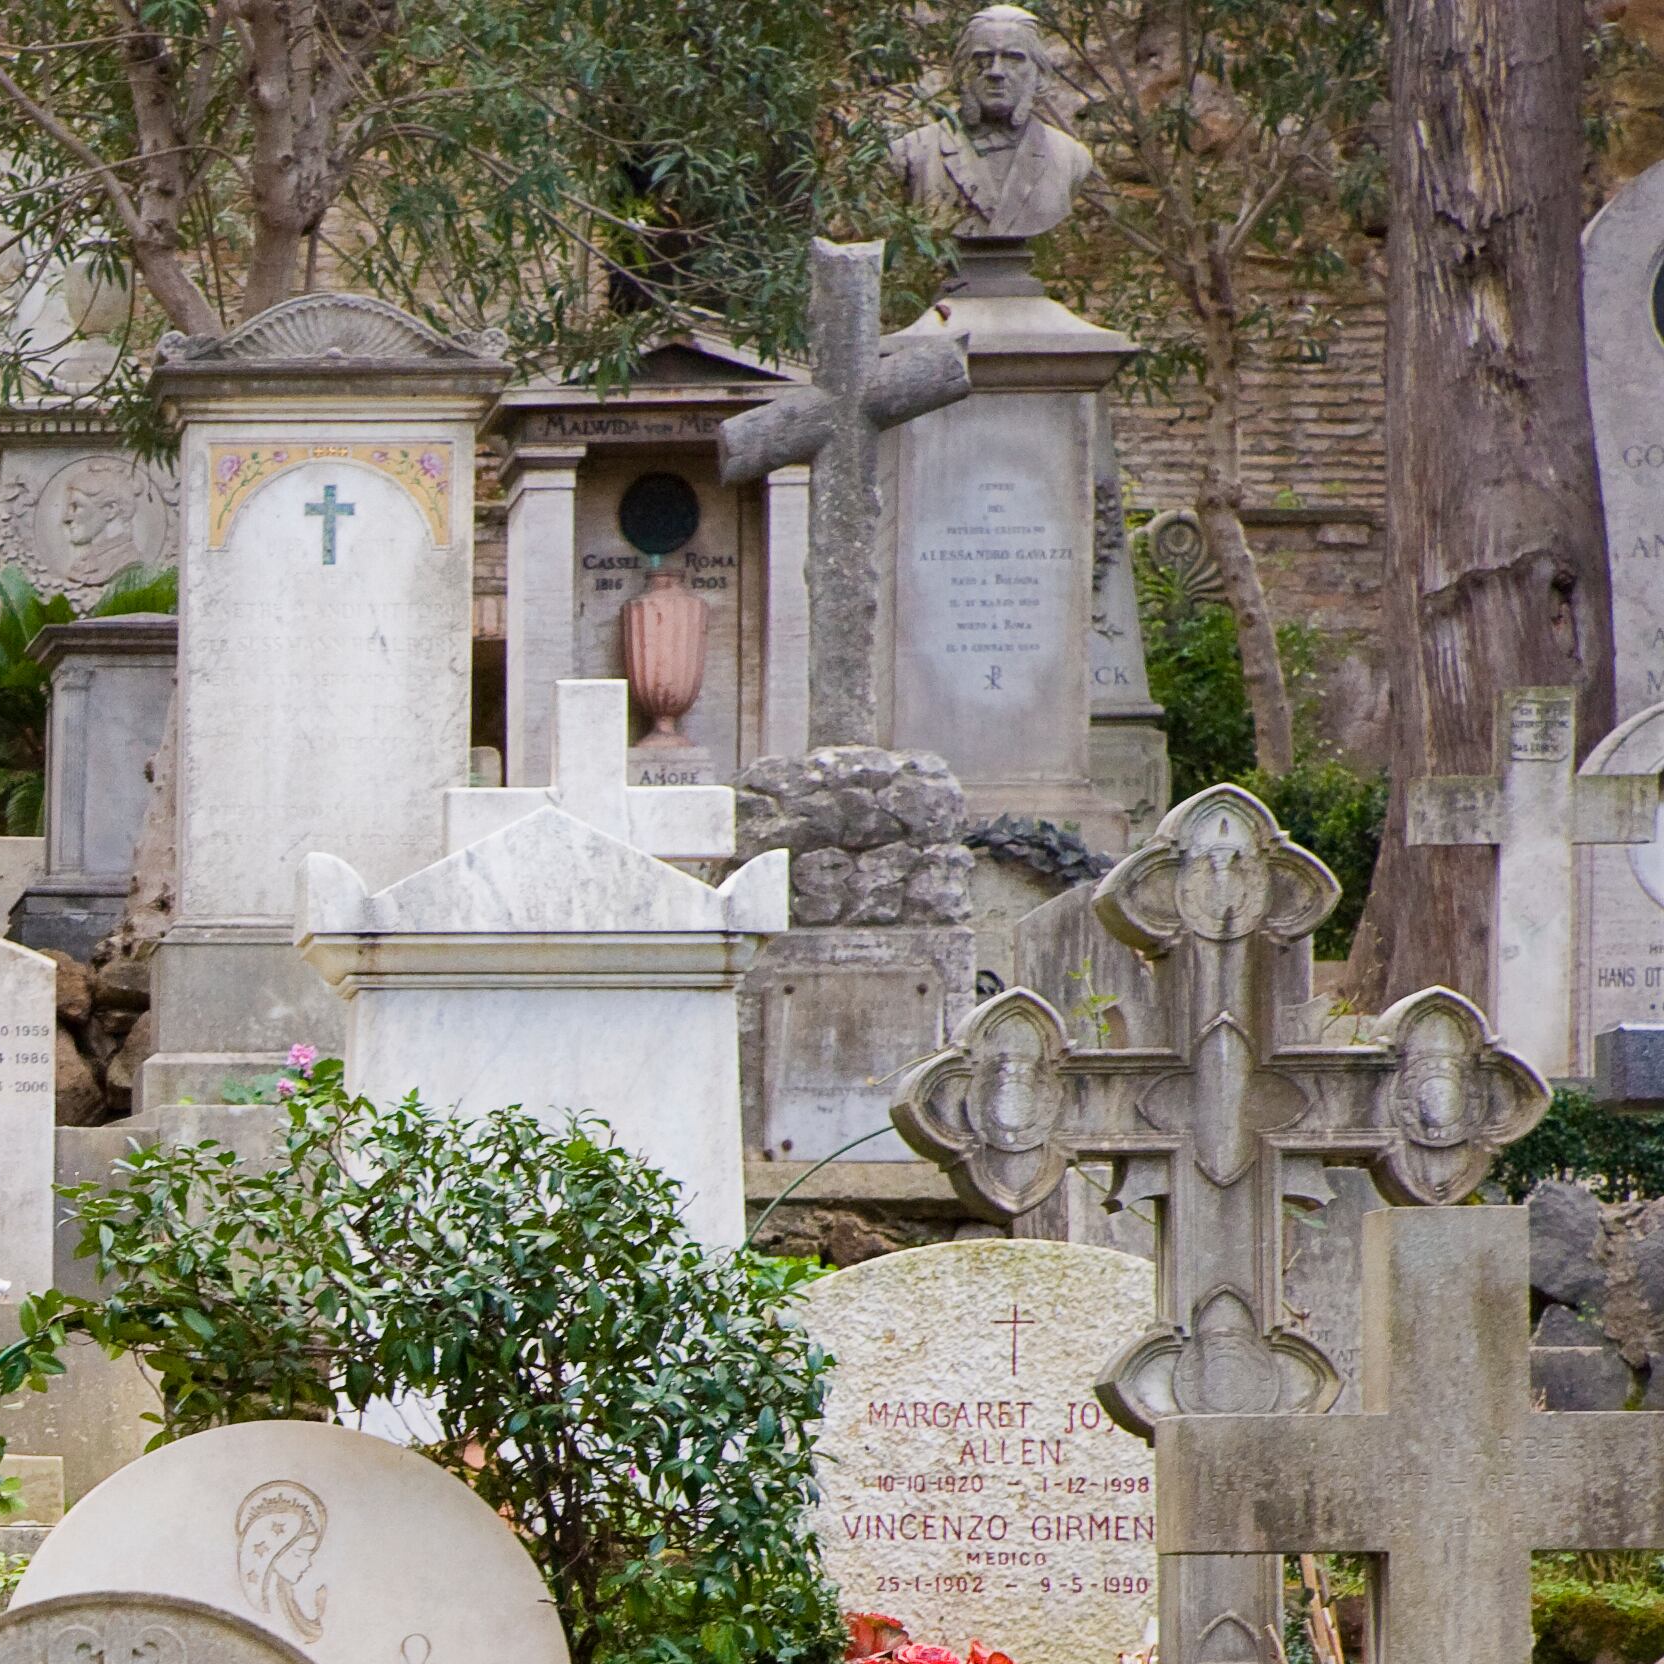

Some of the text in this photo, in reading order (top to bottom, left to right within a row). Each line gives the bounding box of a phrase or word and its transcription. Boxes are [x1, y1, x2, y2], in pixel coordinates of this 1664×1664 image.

[583, 553, 736, 572] CASSEL ROMA
[920, 550, 1009, 562] ALESSANDRO
[639, 769, 701, 785] AMORE
[1597, 966, 1636, 988] HANS
[15, 1025, 50, 1037] 1959
[15, 1052, 50, 1064] 1986
[15, 1081, 50, 1093] 2006
[867, 1401, 1033, 1430] MARGARET
[958, 1438, 1065, 1466] ALLEN
[841, 1513, 1008, 1542] VINCENZO
[965, 1552, 1048, 1566] MEDICO
